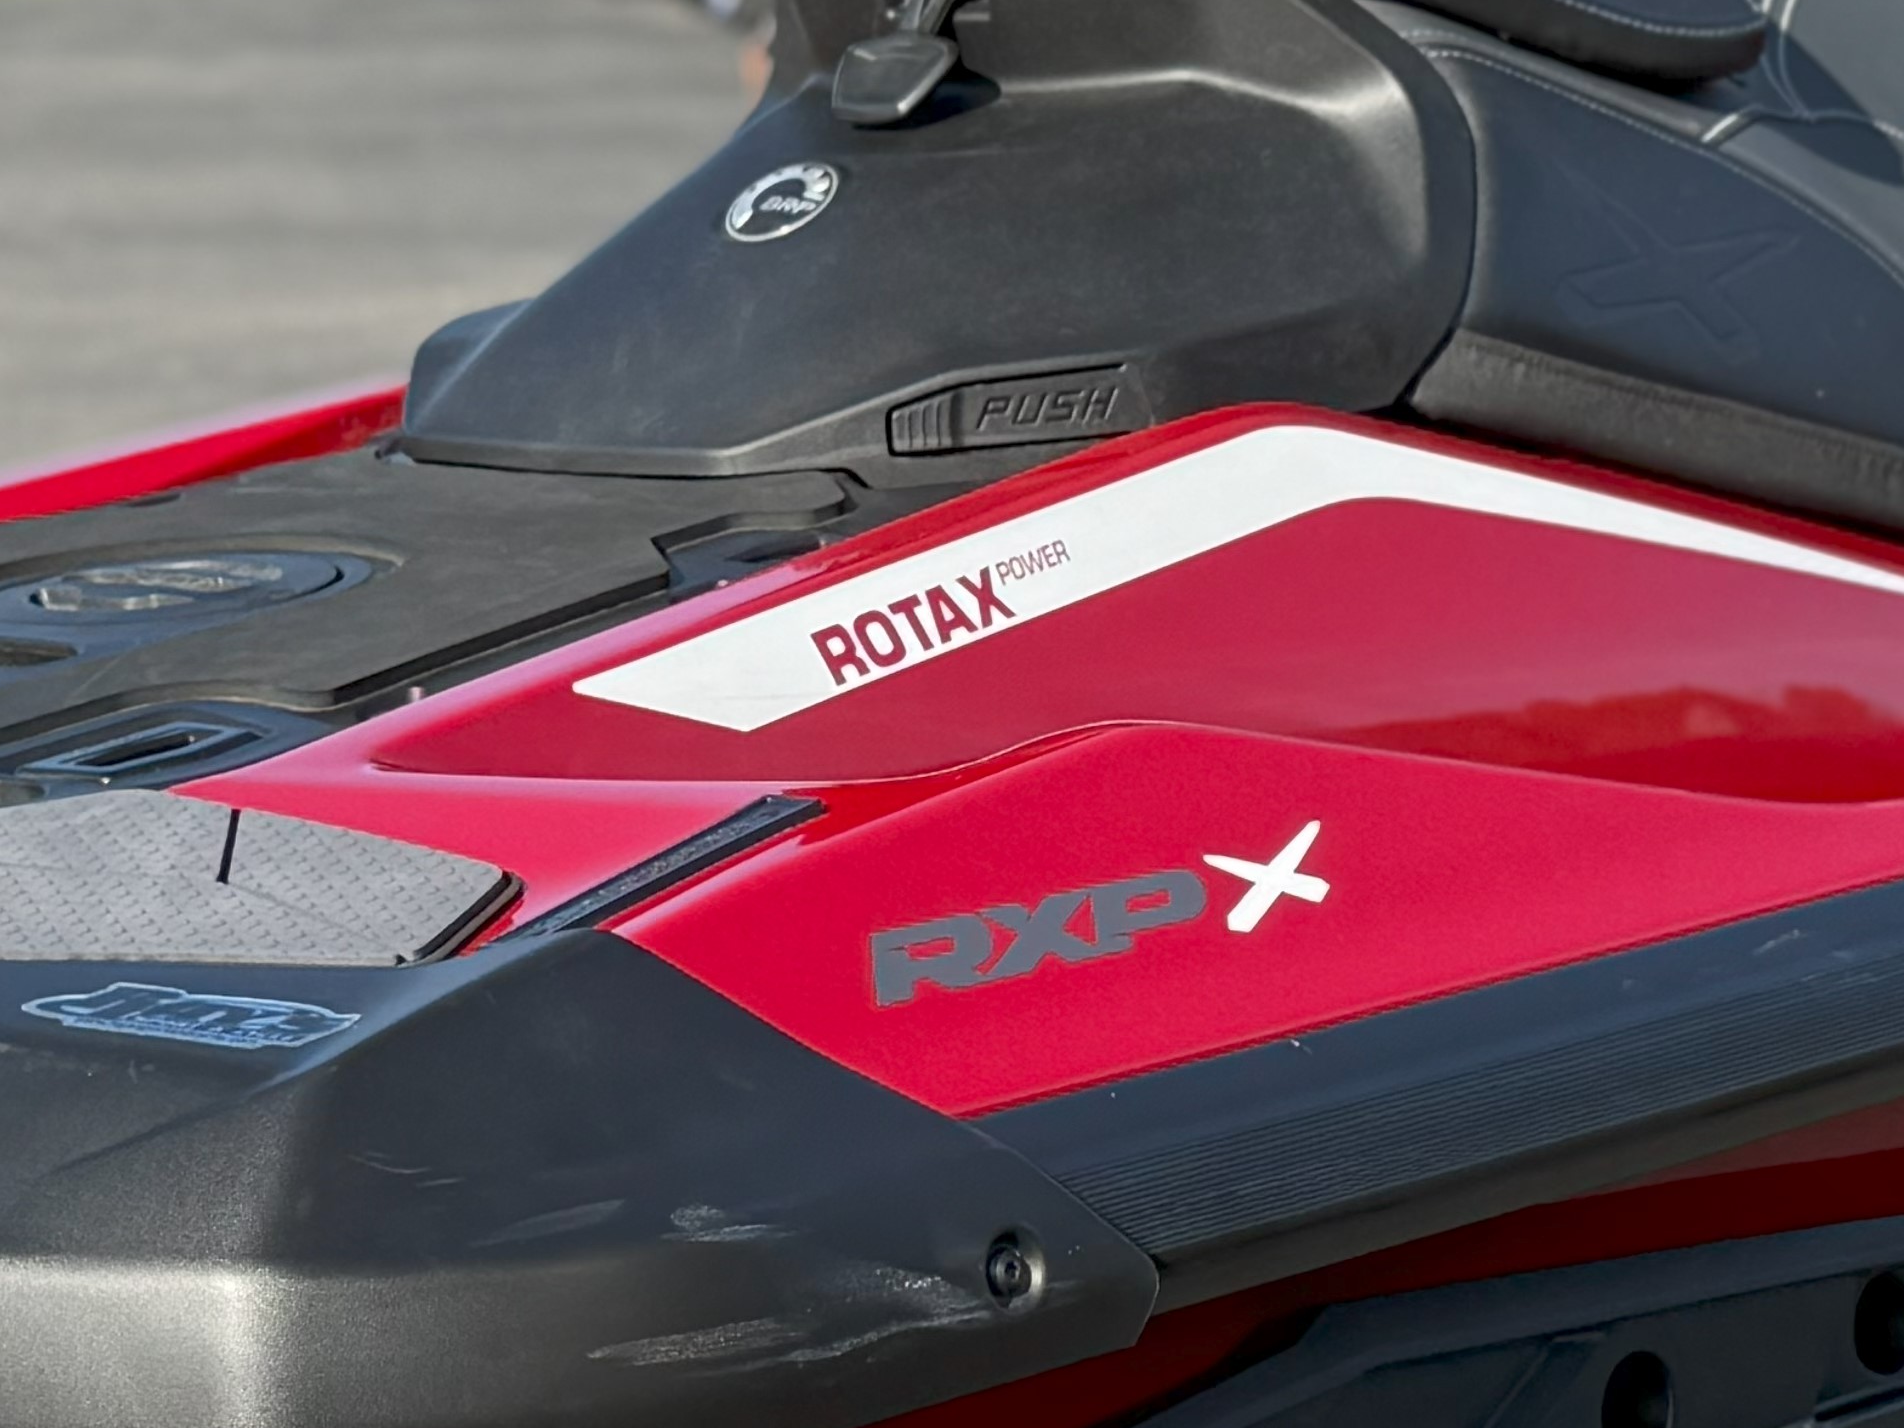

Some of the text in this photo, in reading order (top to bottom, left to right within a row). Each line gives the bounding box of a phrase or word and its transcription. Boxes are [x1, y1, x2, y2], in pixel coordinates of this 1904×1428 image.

[758, 195, 818, 214] BRP
[976, 386, 1119, 432] PUSH
[810, 539, 1071, 686] ROTAX POWER
[870, 819, 1331, 1008] RXP X
